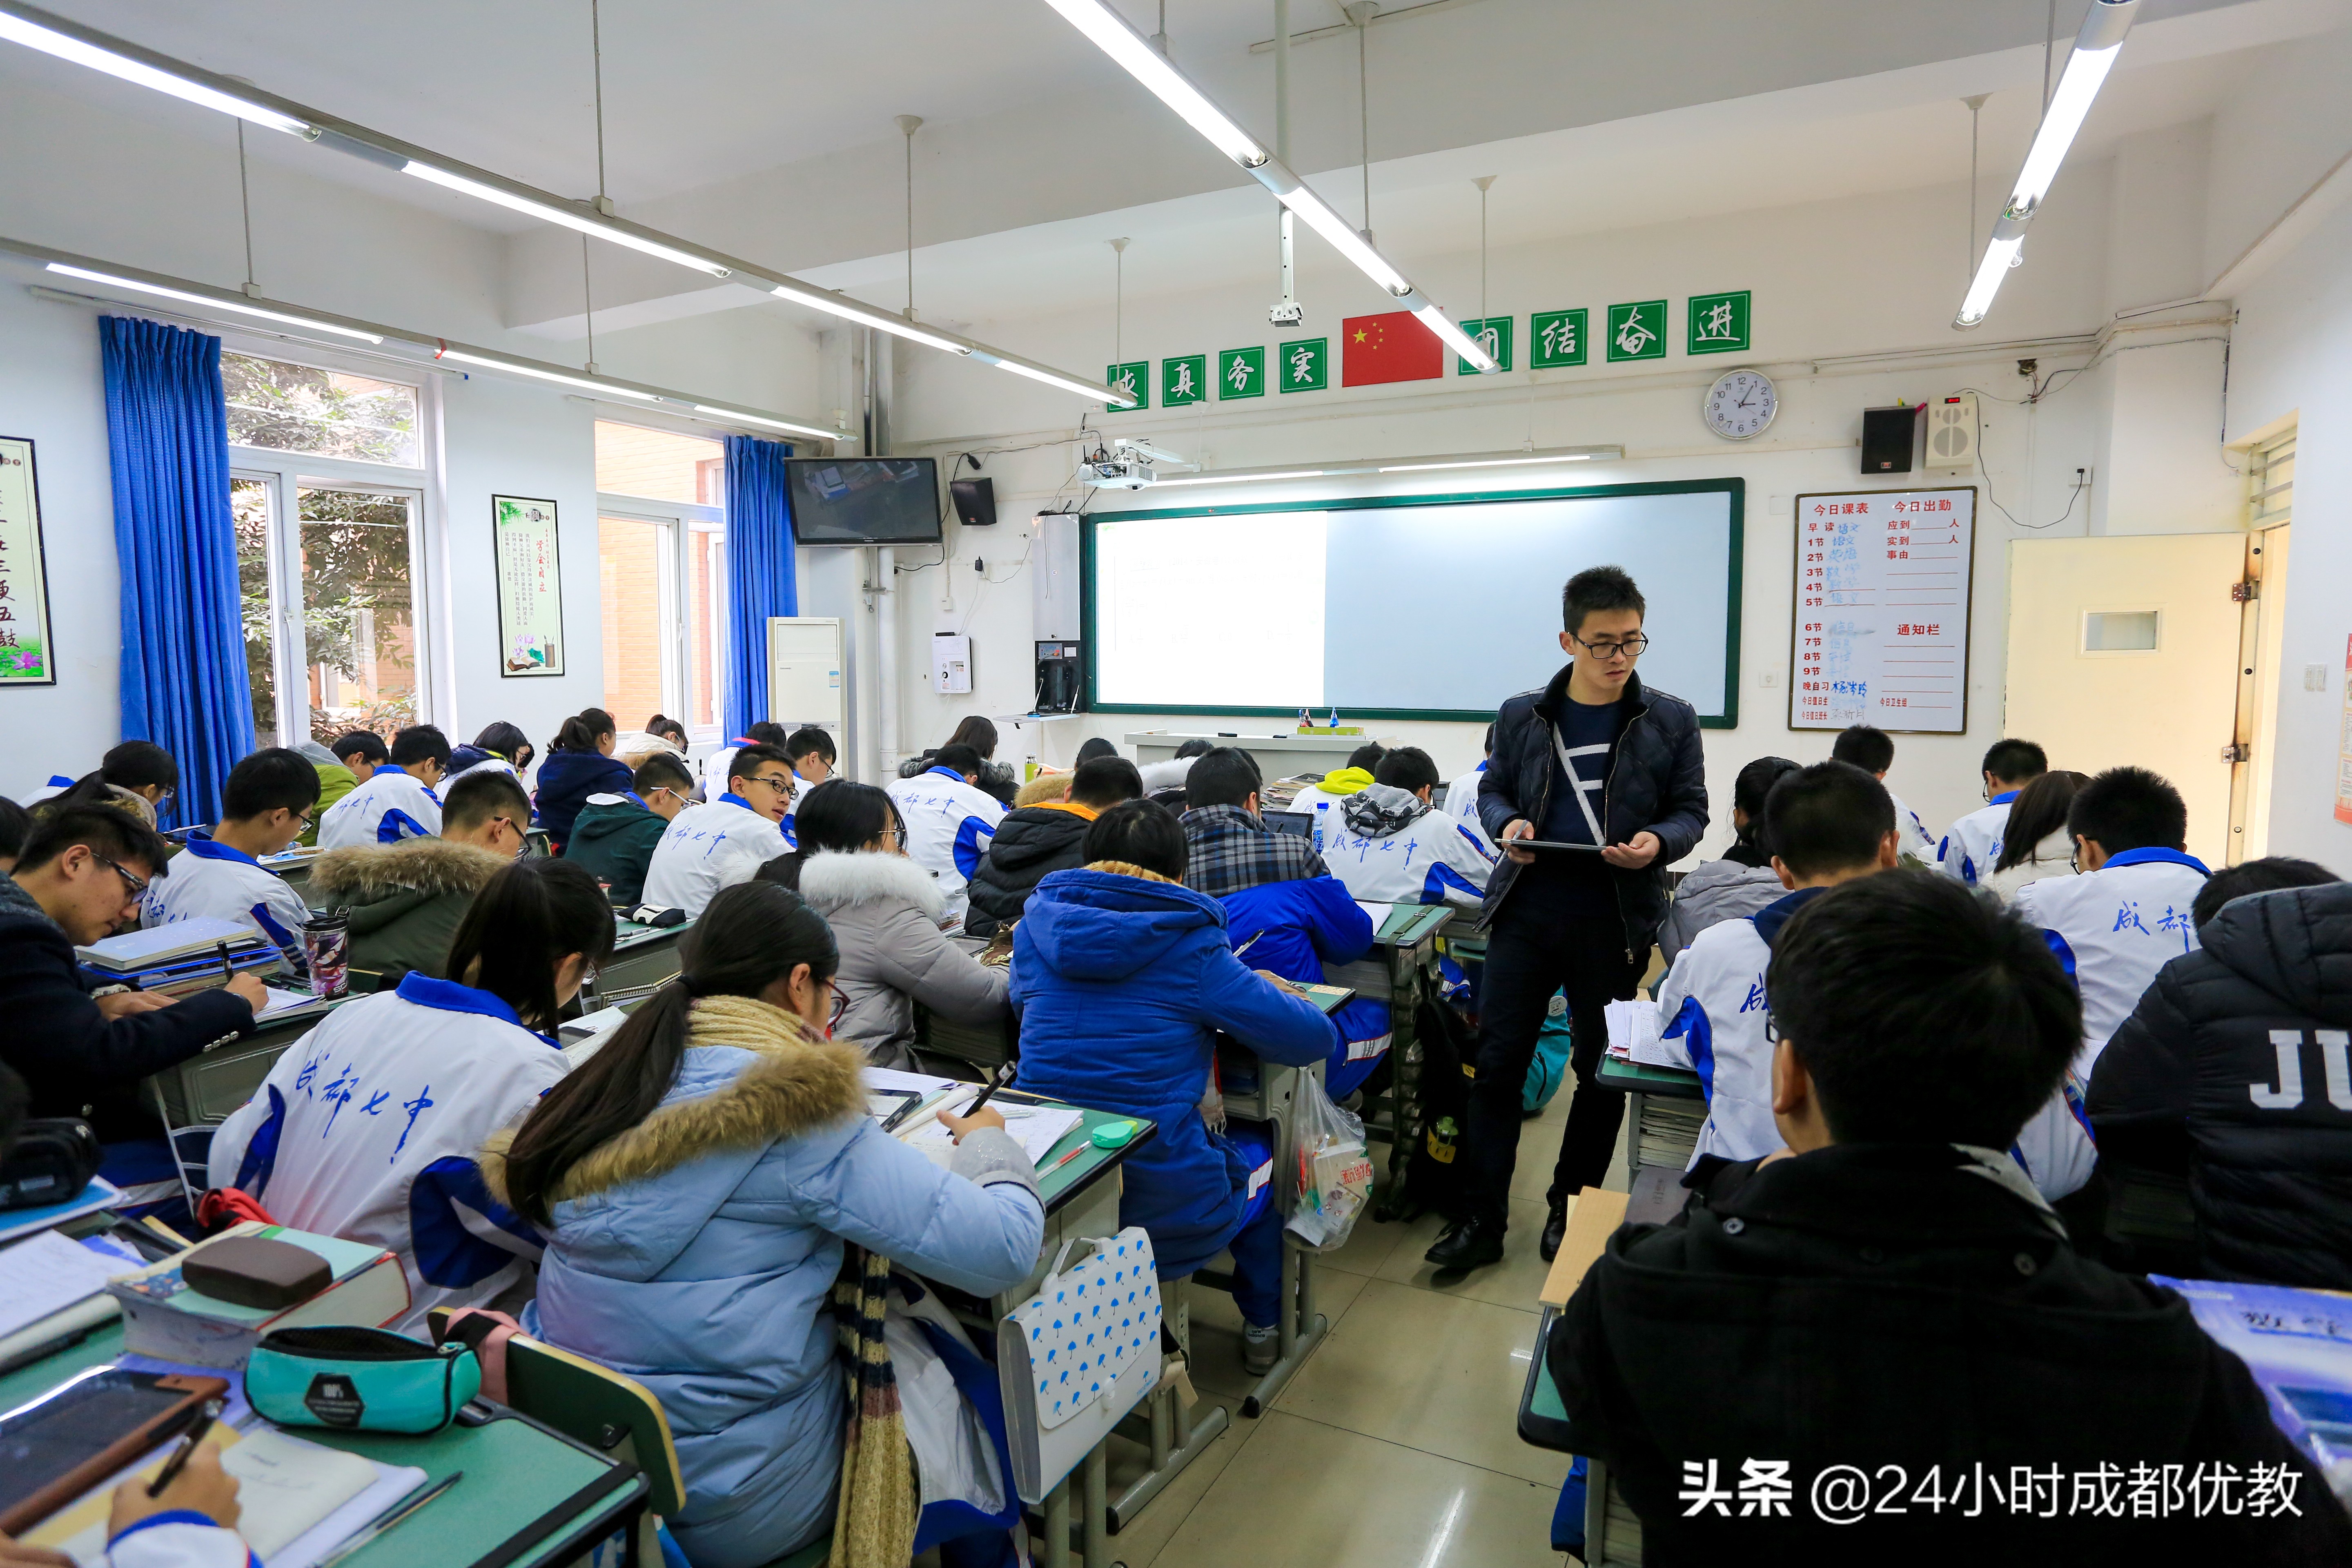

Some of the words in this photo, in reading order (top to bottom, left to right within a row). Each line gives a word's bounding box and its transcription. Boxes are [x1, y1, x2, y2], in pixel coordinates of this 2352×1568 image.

[1814, 502, 1869, 516] 今日课表
[1895, 499, 1951, 512] 今日出勤
[1888, 520, 1910, 530] 应到
[1949, 518, 1959, 528] 人
[1808, 538, 1824, 546] 1节
[1887, 536, 1909, 546] 实到
[1949, 535, 1958, 543] 人
[1807, 553, 1823, 562] 2节
[1886, 550, 1908, 560] 事由
[1807, 568, 1823, 577] 3节
[1806, 583, 1822, 592] 4节
[1806, 597, 1823, 606] 5节
[1805, 623, 1822, 632] 6节
[1898, 624, 1940, 635] 通知栏
[1805, 637, 1822, 646] 7节
[1804, 652, 1821, 661] 8节
[1804, 667, 1820, 675] 9节
[1803, 682, 1829, 690] 晚自习
[1802, 696, 1828, 706] 今日值日生
[1880, 697, 1907, 707] 今日卫生组
[1332, 829, 1418, 871] 成都七中
[296, 1050, 434, 1165] 成都七中
